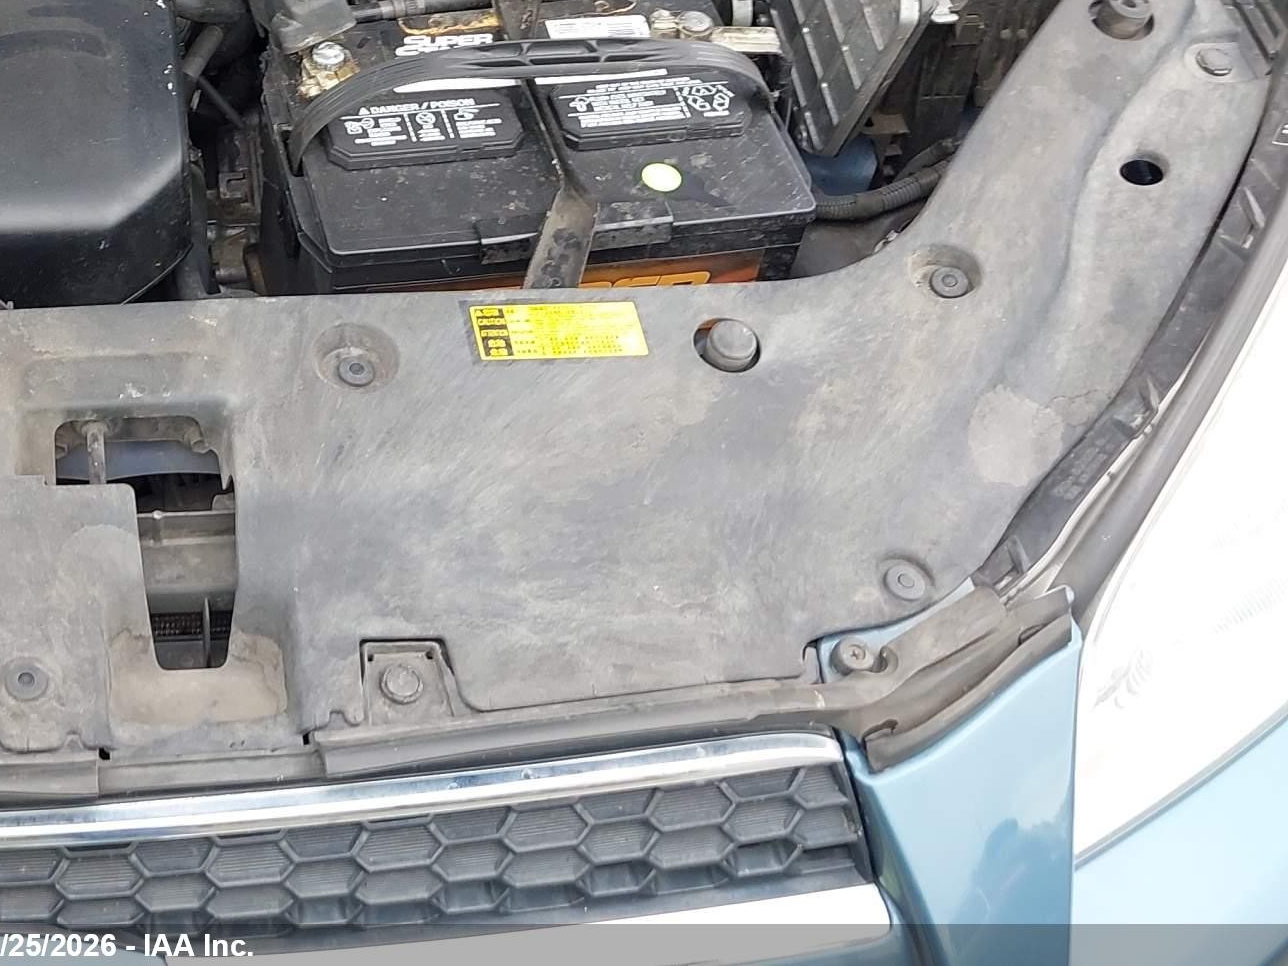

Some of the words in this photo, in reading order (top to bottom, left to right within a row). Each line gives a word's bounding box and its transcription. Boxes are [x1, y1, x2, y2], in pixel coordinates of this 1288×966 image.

[403, 32, 494, 47] SUPER
[370, 102, 420, 115] DANGER
[429, 97, 476, 109] POISON
